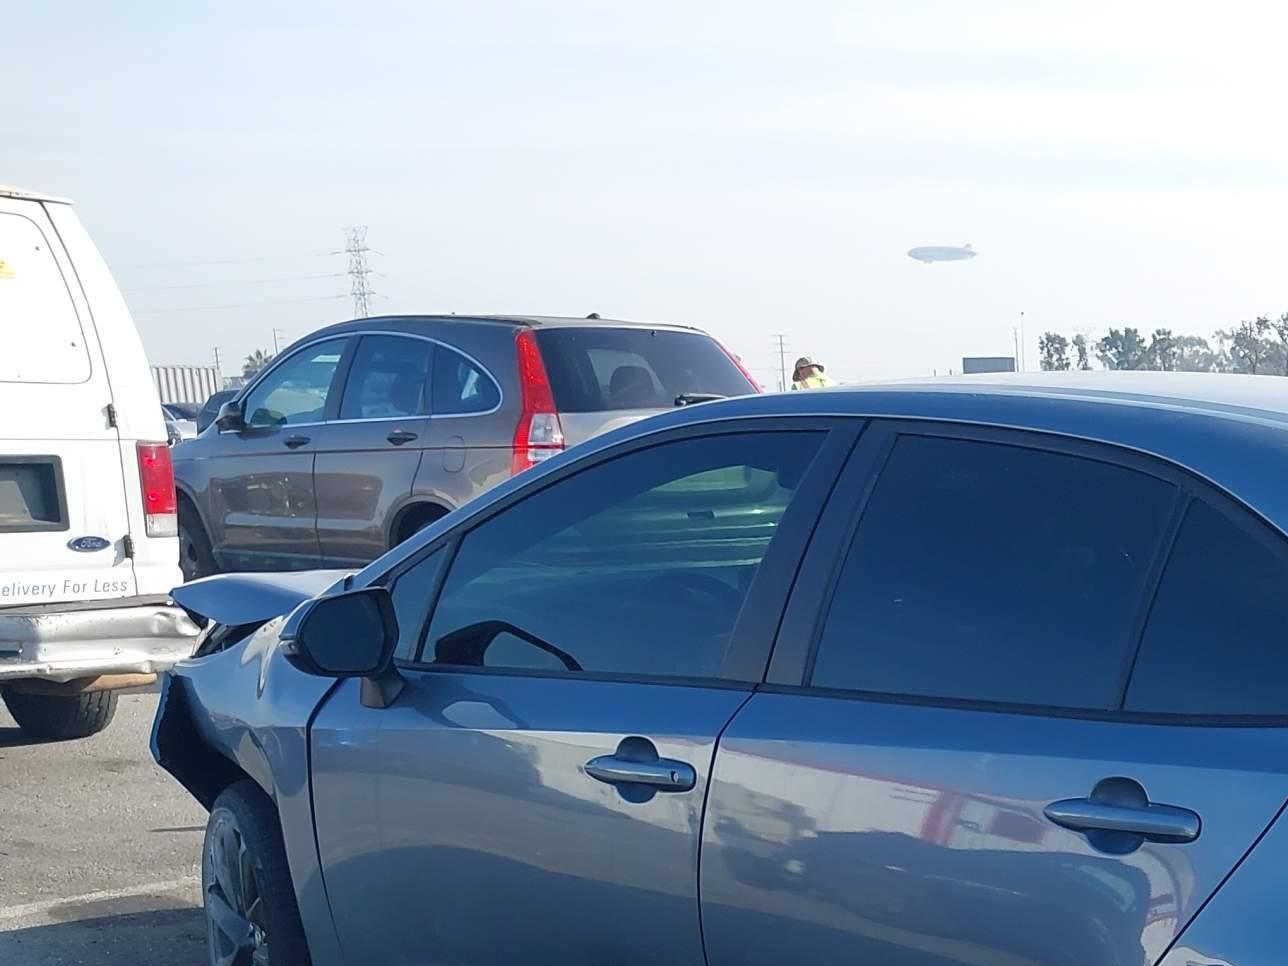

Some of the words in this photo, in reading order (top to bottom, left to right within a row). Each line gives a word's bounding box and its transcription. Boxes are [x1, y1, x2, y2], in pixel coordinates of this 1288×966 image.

[1, 581, 56, 598] elivery
[63, 579, 88, 594] For
[94, 578, 128, 593] Less
